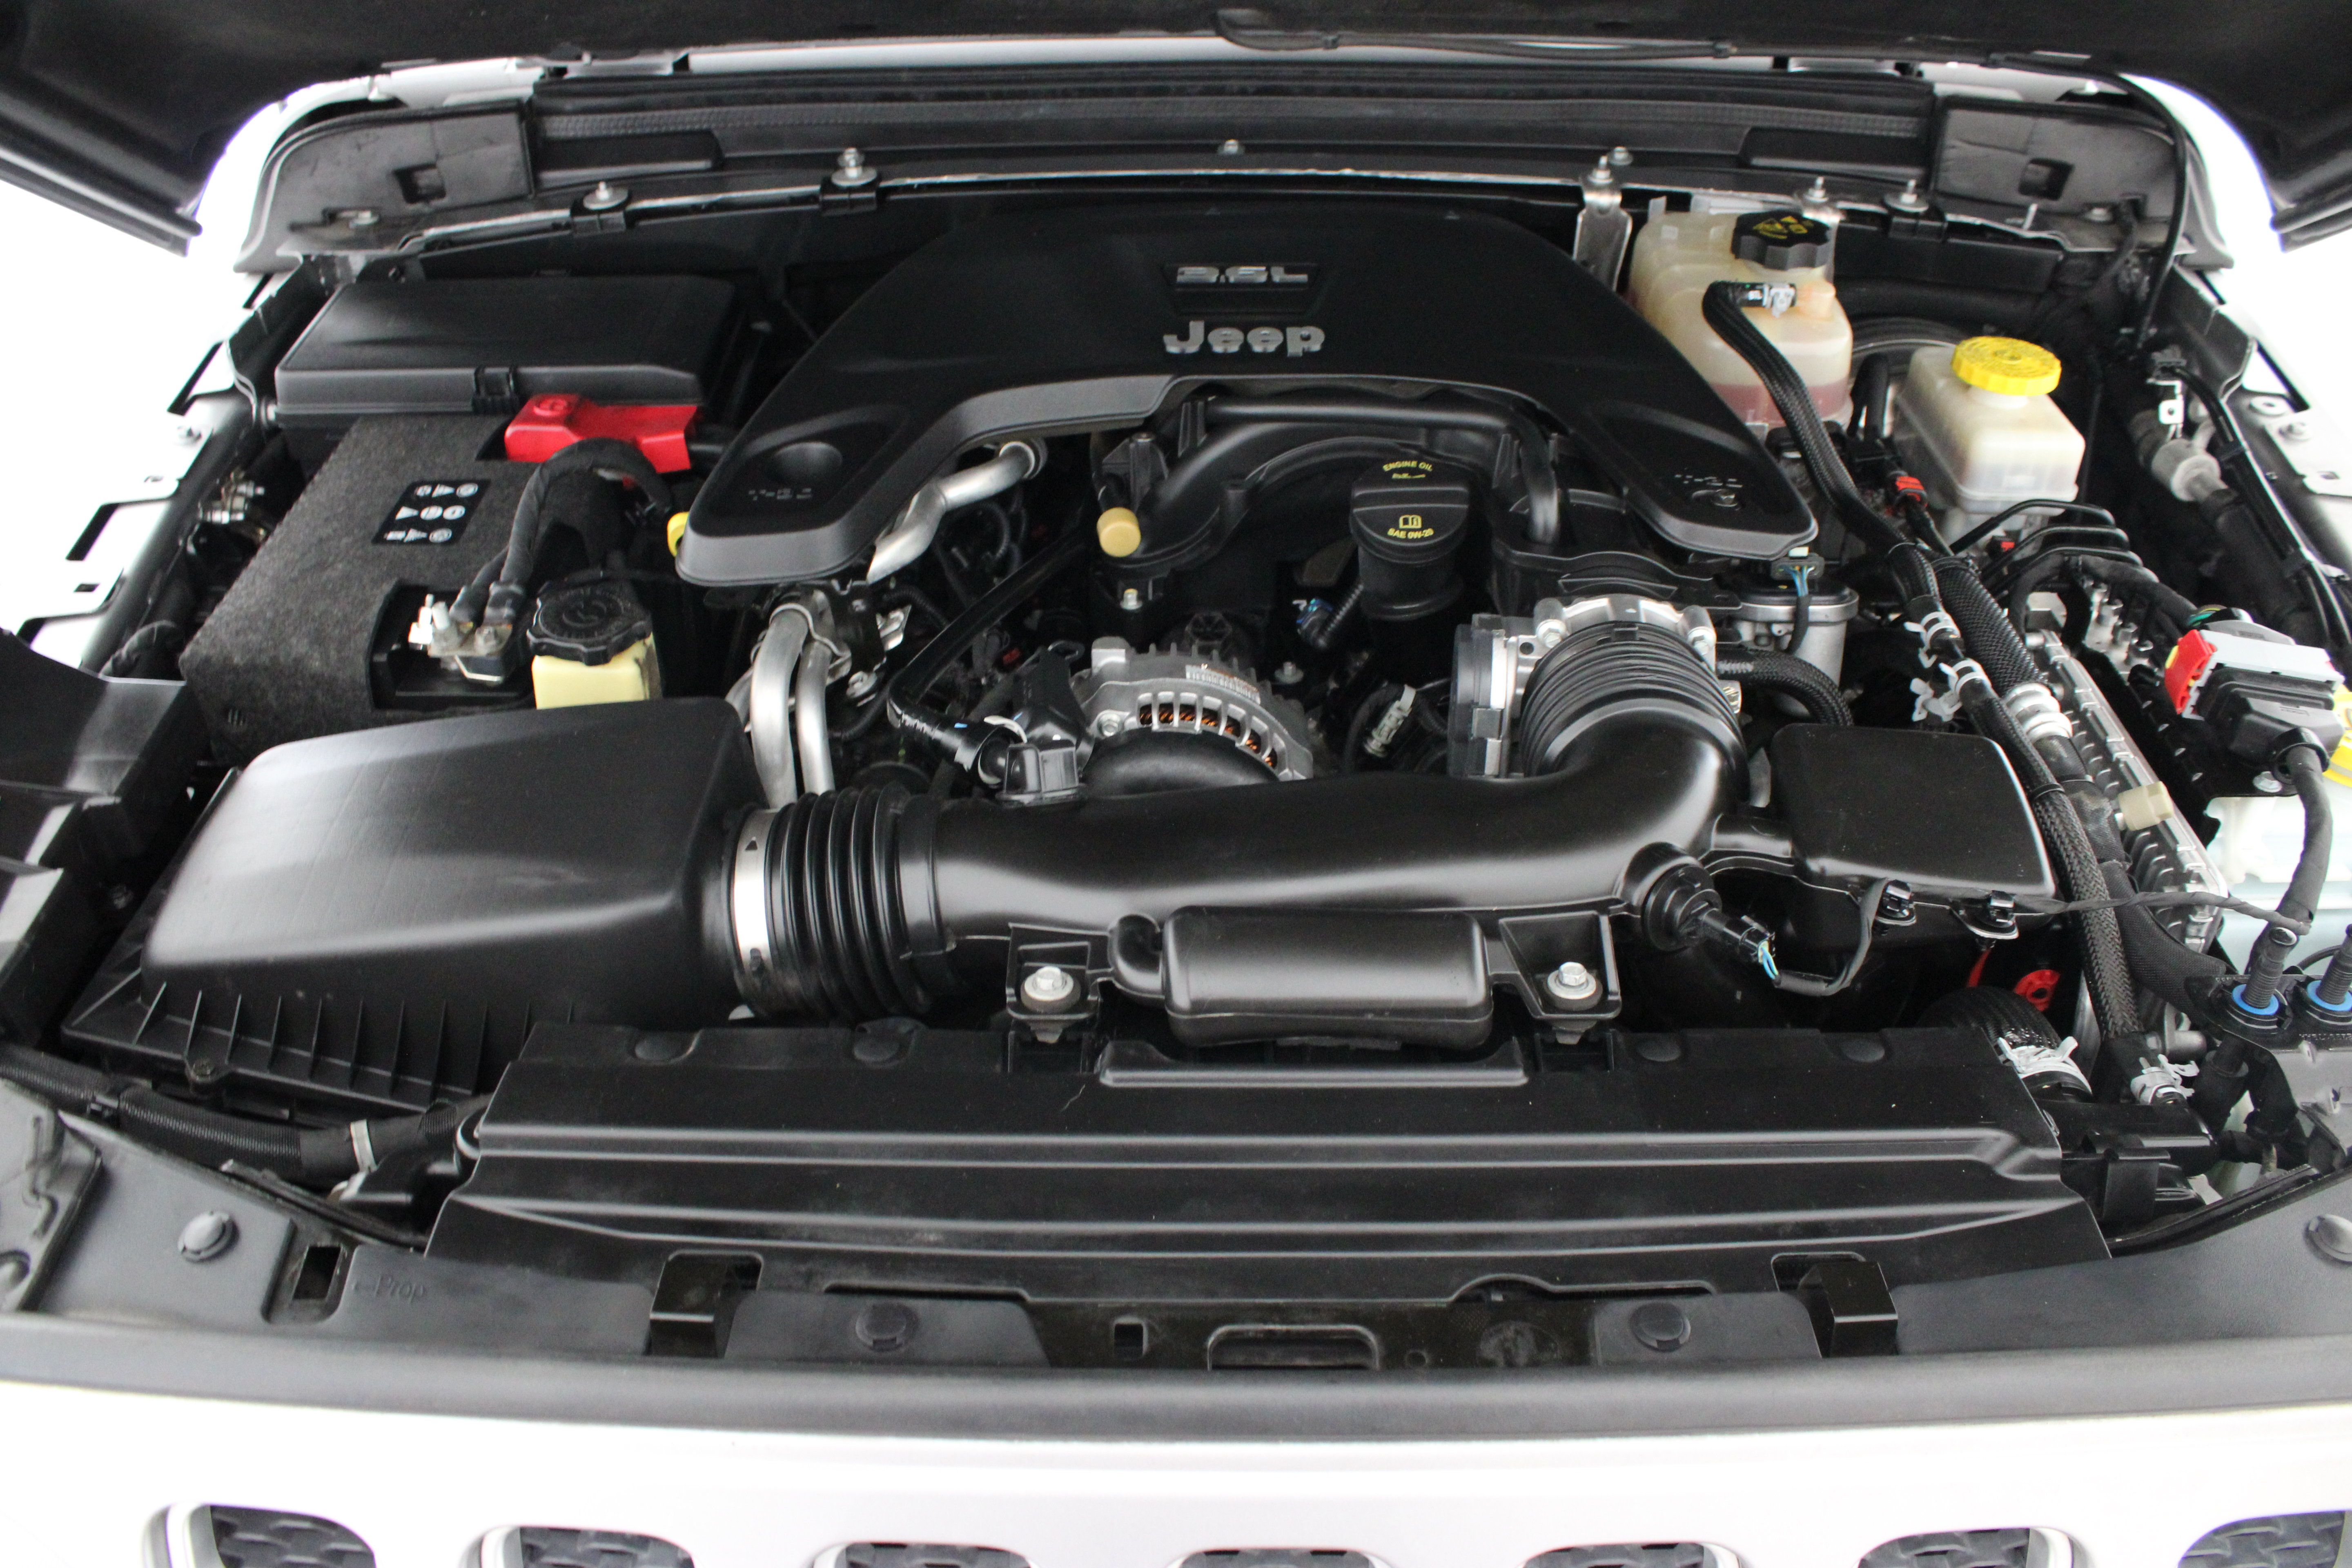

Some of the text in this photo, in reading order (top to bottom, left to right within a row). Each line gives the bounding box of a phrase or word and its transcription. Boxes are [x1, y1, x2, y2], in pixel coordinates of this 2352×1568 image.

[1163, 320, 1325, 357] Jeep
[1383, 461, 1433, 472] ENGINE OIL
[1387, 528, 1434, 539] SAE 0W-20
